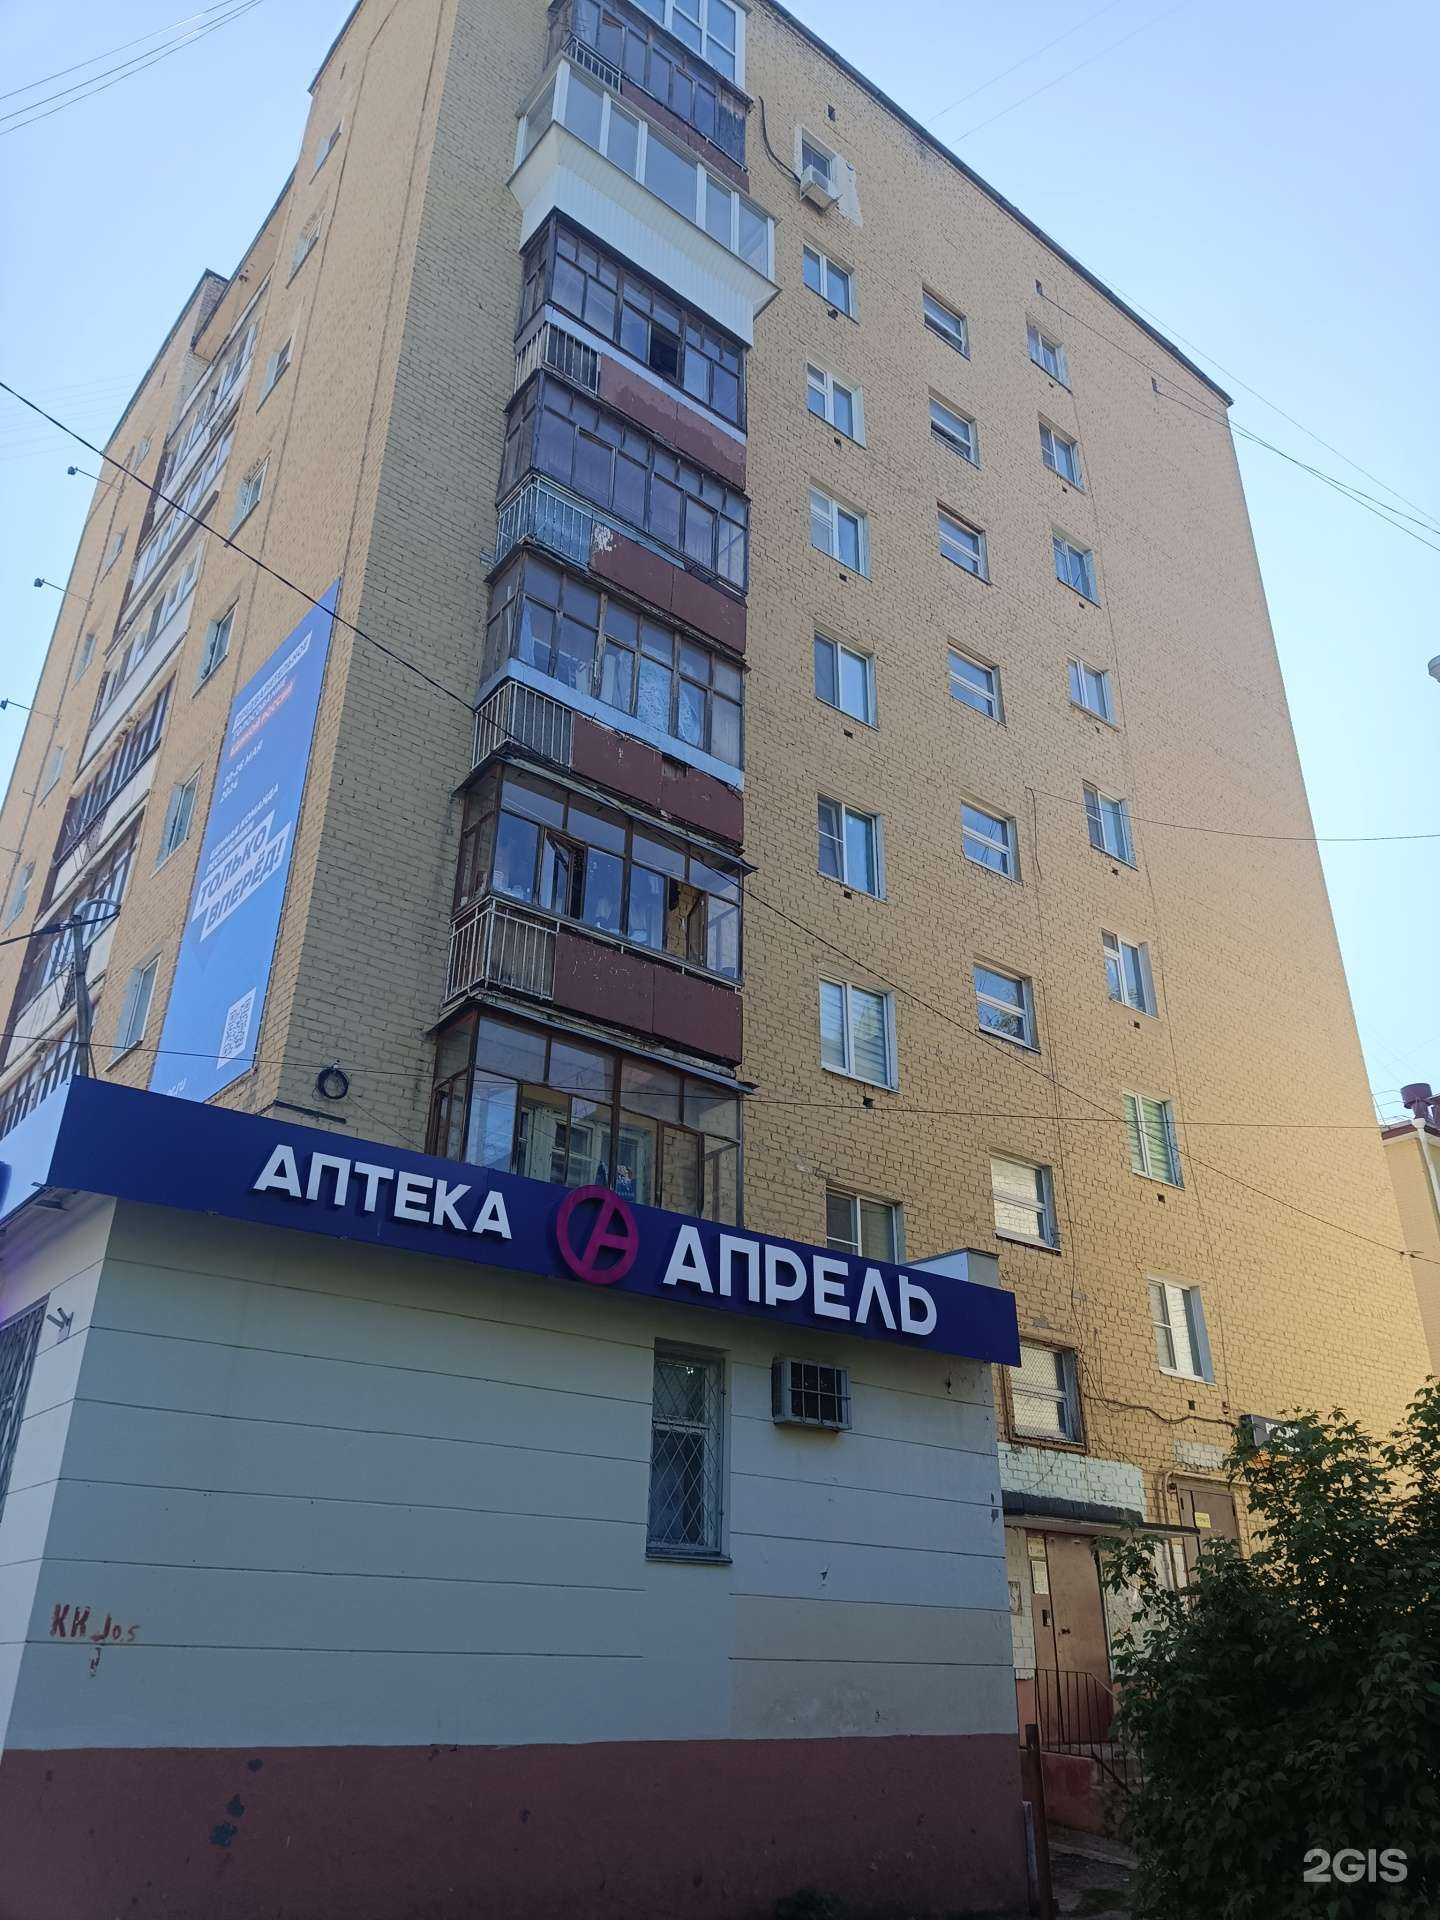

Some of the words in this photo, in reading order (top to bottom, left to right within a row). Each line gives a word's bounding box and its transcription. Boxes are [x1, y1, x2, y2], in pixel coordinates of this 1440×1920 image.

[200, 828, 266, 909] ТОЛЬКО
[210, 837, 282, 922] ВПЕРЁД!
[253, 1143, 513, 1240] АПТЕКА
[662, 1224, 938, 1337] АПРЕЛЬ
